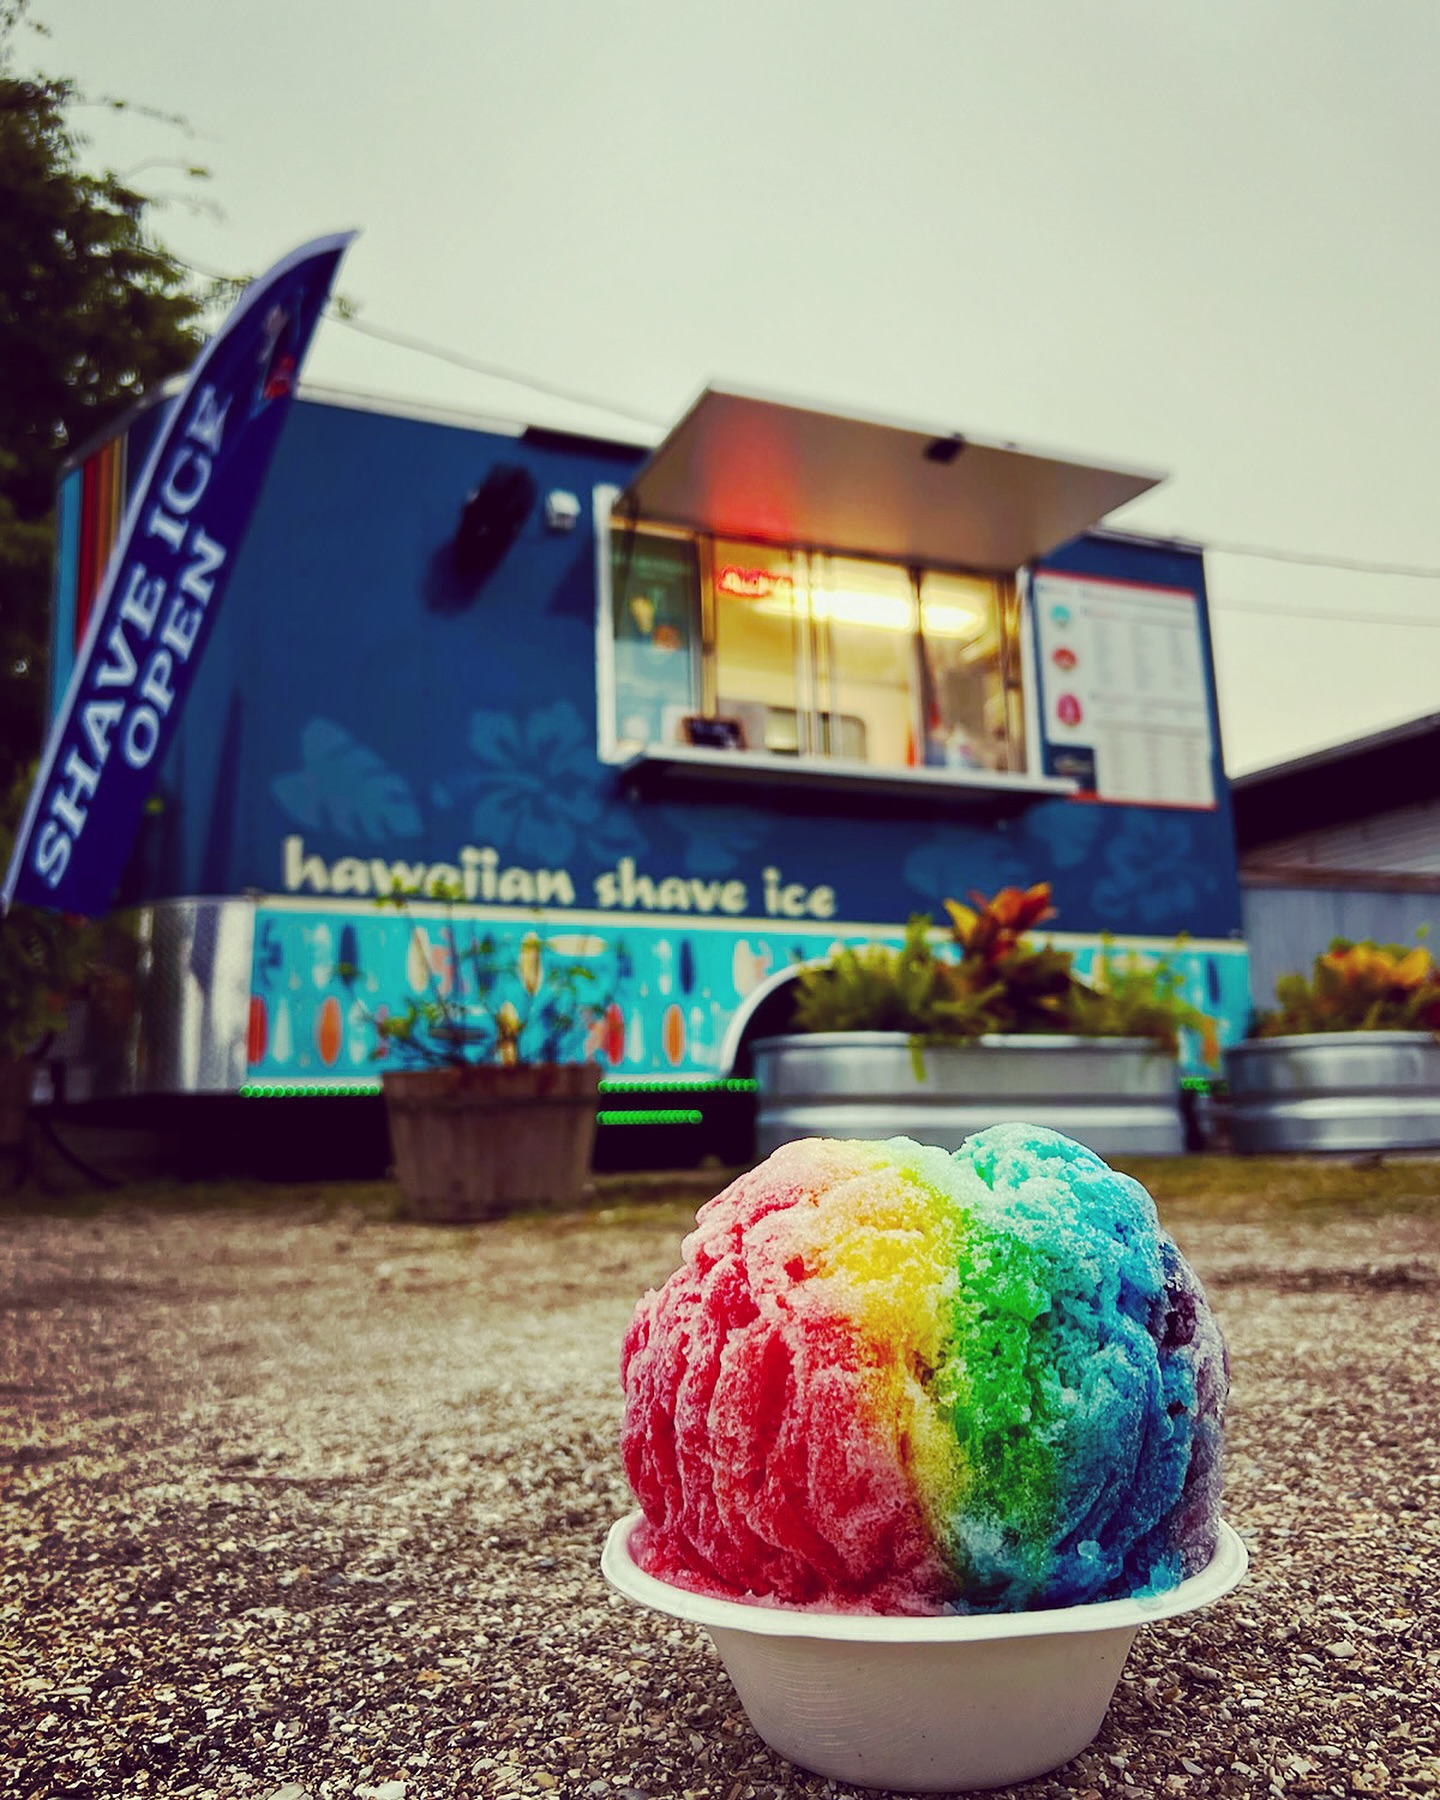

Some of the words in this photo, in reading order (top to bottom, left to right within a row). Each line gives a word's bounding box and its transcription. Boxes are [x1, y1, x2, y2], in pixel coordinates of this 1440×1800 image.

[34, 562, 167, 889] SHAVE
[122, 527, 227, 769] OPEN
[282, 836, 575, 905] hawaiian
[595, 857, 748, 914] shave
[763, 866, 836, 918] ice
